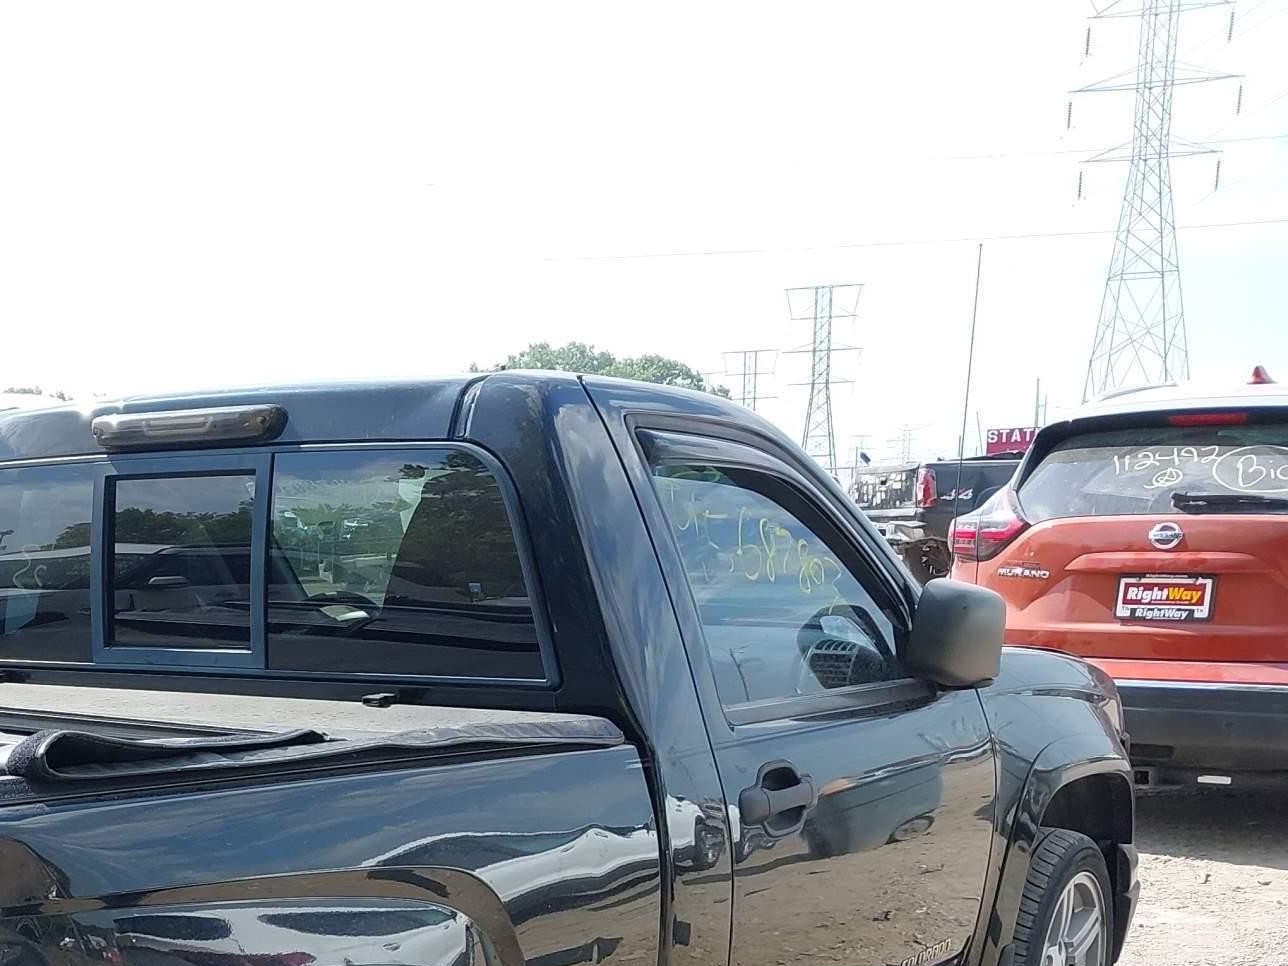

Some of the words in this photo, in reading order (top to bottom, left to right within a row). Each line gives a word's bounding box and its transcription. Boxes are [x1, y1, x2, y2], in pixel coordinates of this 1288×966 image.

[998, 567, 1050, 578] MURANO
[1126, 586, 1202, 603] RightWay
[1135, 608, 1189, 620] RightWay
